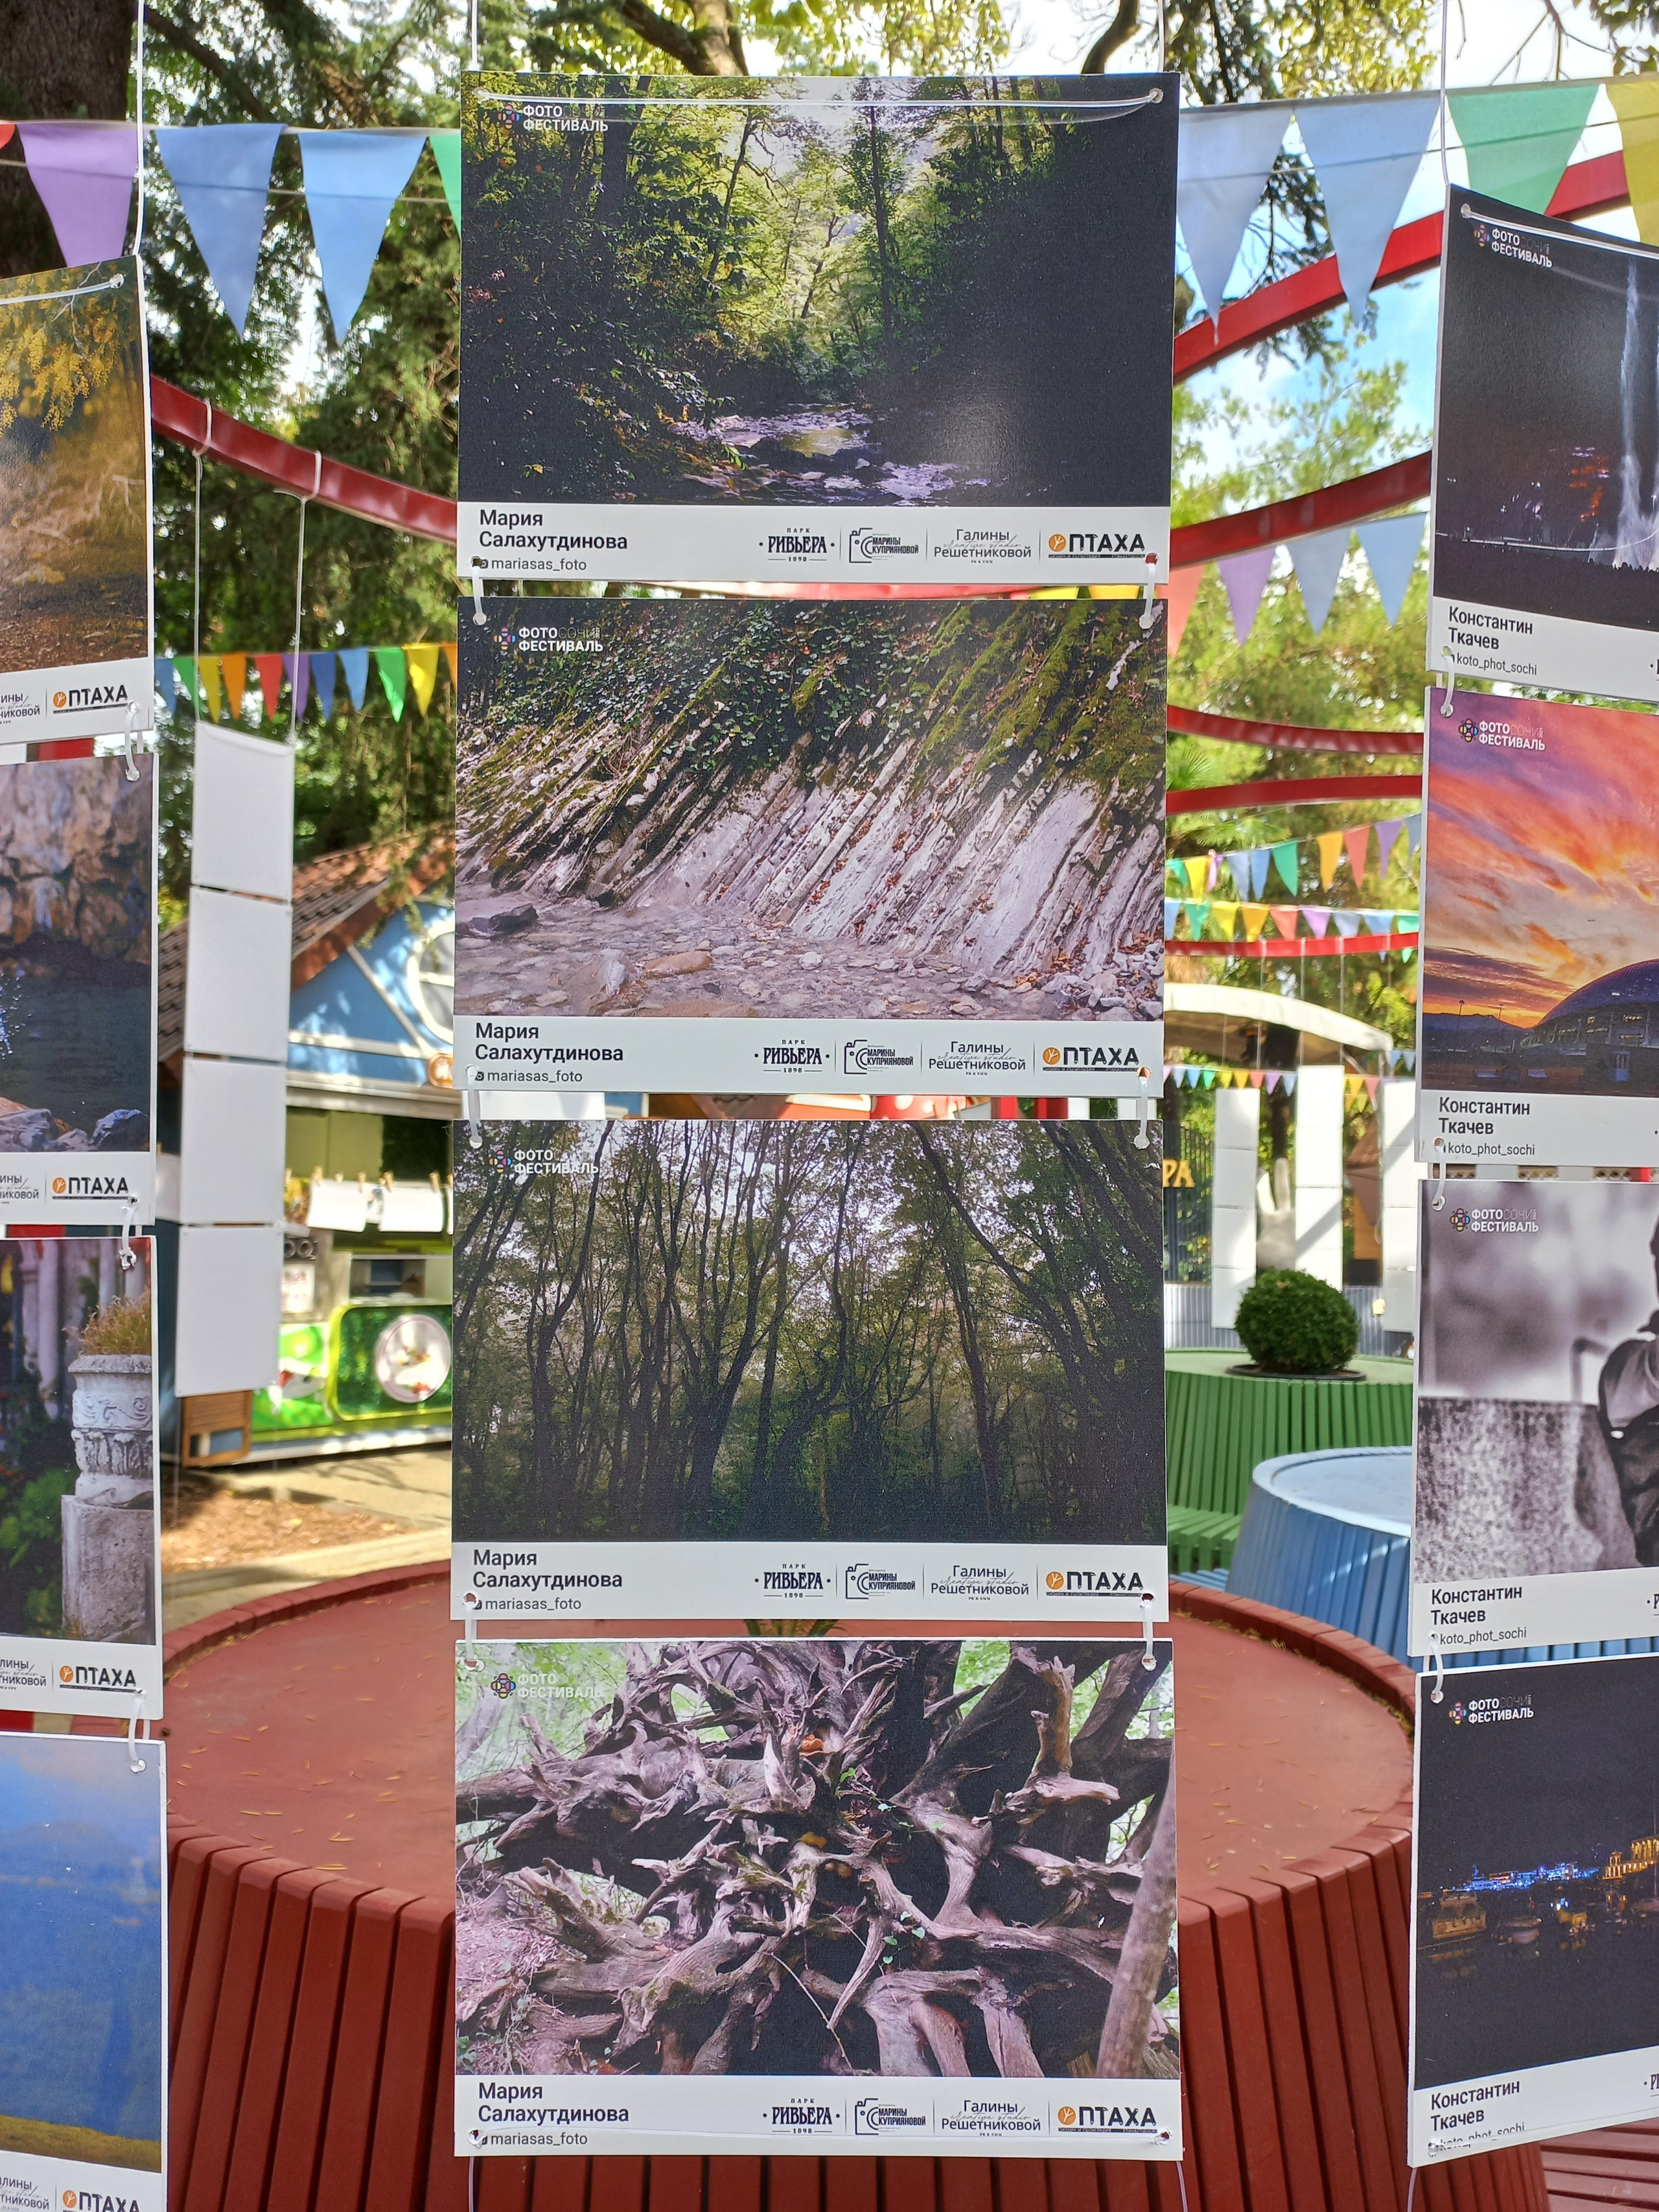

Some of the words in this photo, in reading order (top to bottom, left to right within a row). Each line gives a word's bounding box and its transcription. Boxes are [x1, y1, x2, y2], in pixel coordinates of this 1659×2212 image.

[523, 119, 609, 132] ФЕСТИВАЛЬ
[1491, 241, 1553, 268] ФЕСТИВАЛЬ
[480, 509, 542, 530] Мария
[480, 531, 627, 553] Салахутдинова
[957, 529, 1009, 541] Галины
[1069, 534, 1144, 552] ПТАХА
[768, 536, 828, 553] РИВЬЕРА
[872, 544, 919, 554] КУПРИЯНОВОЙ
[934, 546, 1031, 557] Решетниковой
[491, 557, 586, 571] mariasas_foto
[1449, 606, 1533, 634] Константин
[519, 640, 603, 652] ФЕСТИВАЛЬ
[1448, 627, 1499, 649] Ткачев
[1457, 653, 1537, 675] koto_phot_sochi
[69, 685, 128, 707] ПТАХА
[1479, 733, 1546, 751] ФЕСТИВАЛЬ
[476, 1023, 539, 1043] Мария
[475, 1044, 623, 1064] Салахутдинова
[763, 1047, 822, 1065] РИВЬЕРА
[951, 1042, 1003, 1053] Галины
[867, 1056, 914, 1065] КУПРИЯНОВОЙ
[929, 1060, 1026, 1070] Решетниковой
[1063, 1047, 1139, 1066] ПТАХА
[487, 1070, 583, 1083] mariasas_foto
[1439, 1097, 1530, 1115] Константин
[1439, 1118, 1494, 1135] Ткачев
[1448, 1142, 1535, 1157] koto_phot_sochi
[515, 1162, 599, 1174] ФЕСТИВАЛЬ
[69, 1177, 128, 1194] ПТАХА
[1471, 1221, 1538, 1232] ФЕСТИВАЛЬ
[473, 1550, 537, 1570] Мария
[953, 1565, 1006, 1578] Галины
[473, 1571, 622, 1592] Салахутдинова
[763, 1572, 824, 1590] РИВЬЕРА
[868, 1581, 915, 1590] КУПРИЯНОВОЙ
[931, 1583, 1028, 1594] Решетниковой
[1067, 1572, 1143, 1590] ПТАХА
[486, 1598, 581, 1611] mariasas_foto
[1432, 1587, 1522, 1605] Константин
[1431, 1610, 1486, 1625] Ткачев
[1440, 1627, 1527, 1645] koto_phot_sochi
[76, 1666, 137, 1686] ПТАХА
[518, 1686, 603, 1699] ФЕСТИВАЛЬ
[1468, 1707, 1534, 1724] ФЕСТИВАЛЬ
[479, 2082, 543, 2103] Мария
[1431, 2081, 1520, 2110] Константин
[964, 2100, 1017, 2112] Галины
[478, 2105, 629, 2126] Салахутдинова
[772, 2106, 833, 2125] РИВЬЕРА
[879, 2116, 925, 2126] КУПРИЯНОВОЙ
[1079, 2106, 1157, 2126] ПТАХА
[1430, 2110, 1485, 2131] Ткачев
[942, 2119, 1041, 2130] Решетниковой
[491, 2132, 588, 2147] mariasas_foto
